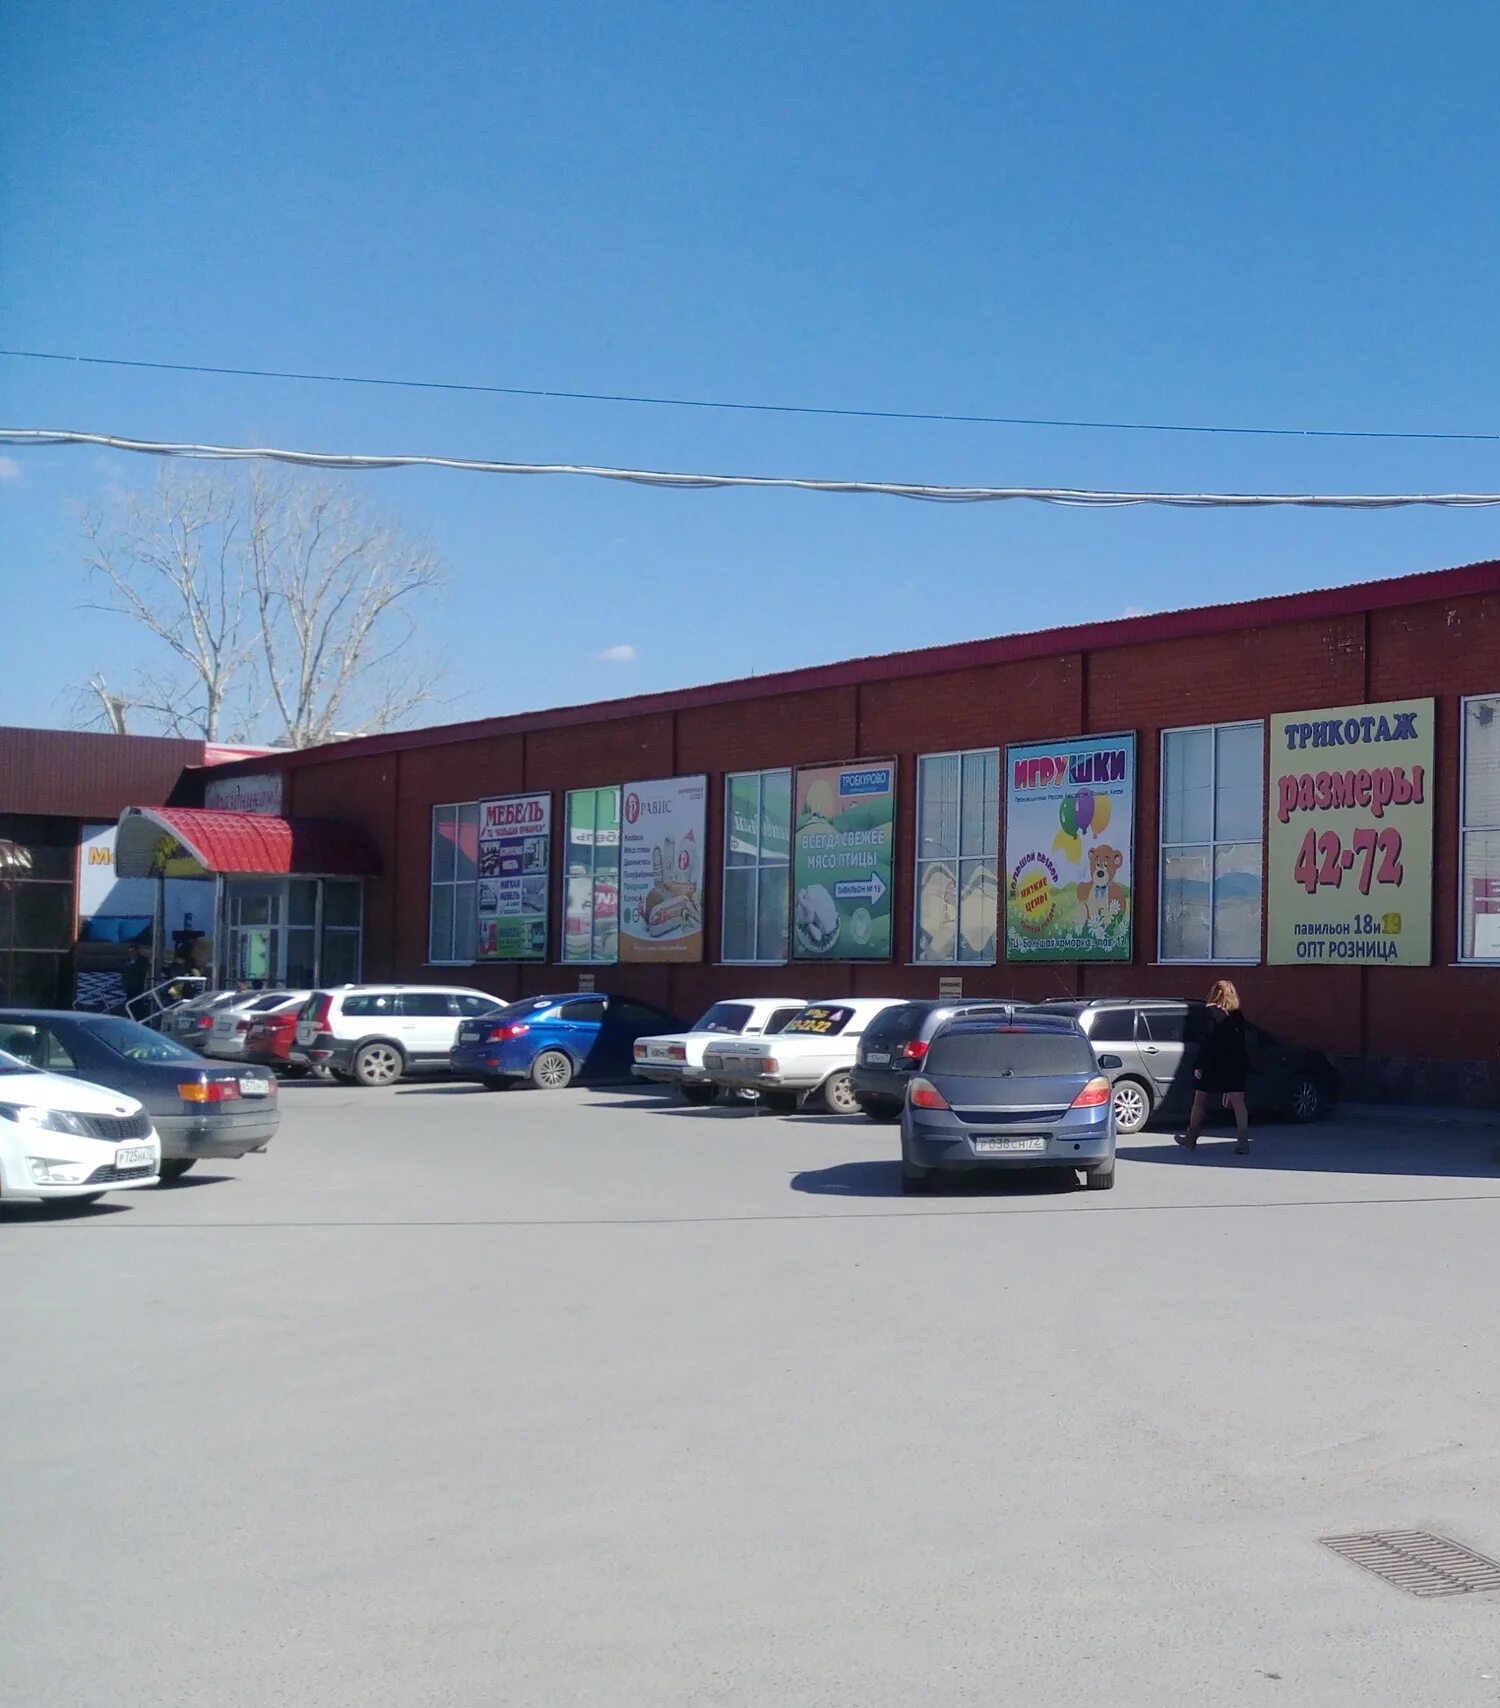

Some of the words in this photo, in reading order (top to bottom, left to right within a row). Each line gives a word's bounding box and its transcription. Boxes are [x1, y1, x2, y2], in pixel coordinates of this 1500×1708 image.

[1284, 713, 1418, 750] ТРИКОТАЖ
[842, 772, 887, 787] ТРОЕКУРОВО
[1014, 749, 1127, 790] ИГРУШКИ
[1277, 764, 1425, 823] размеры
[486, 801, 544, 826] МЕБЕЛЬ
[802, 832, 841, 850] ВСЕГДА
[842, 830, 885, 847] СВЕЖЕЕ
[807, 854, 837, 869] МЯСО
[838, 851, 877, 868] ПТИЦЫ
[1294, 827, 1402, 895] 42-72
[1294, 922, 1350, 936] павильон
[1297, 943, 1326, 959] ОПТ
[1329, 940, 1398, 961] РОЗНИЦА
